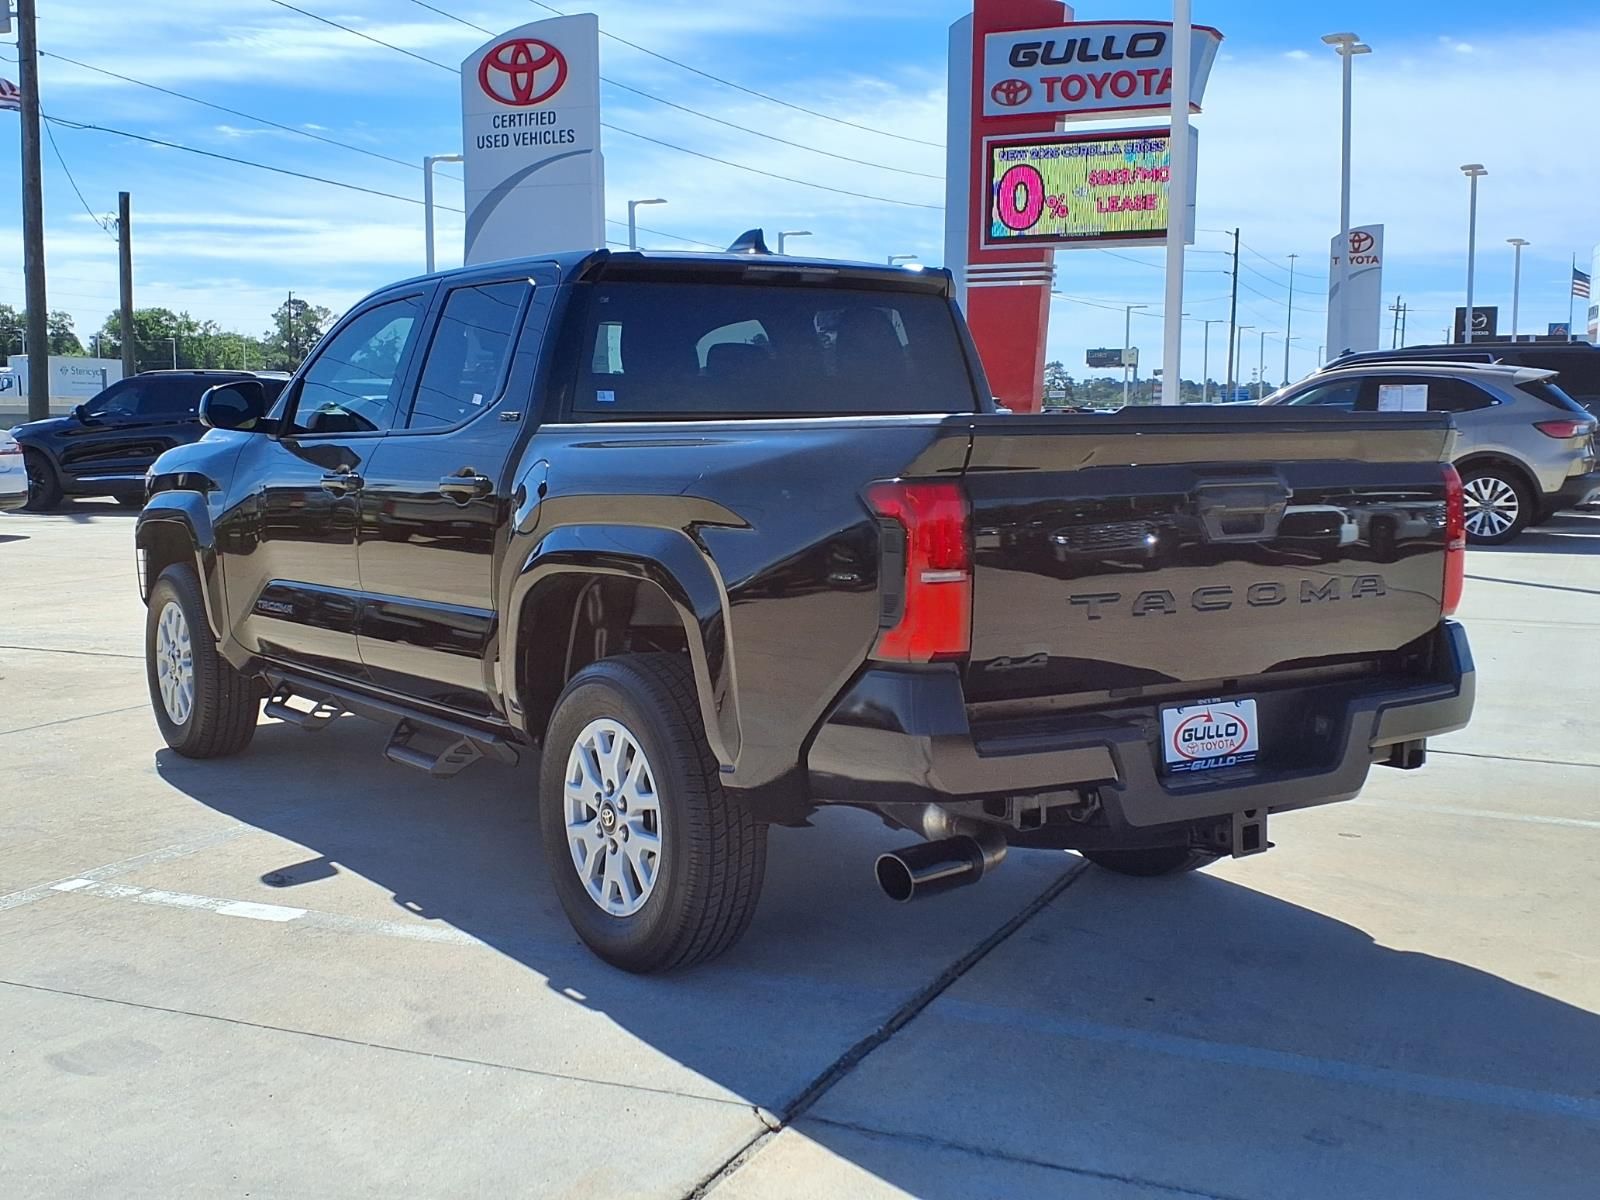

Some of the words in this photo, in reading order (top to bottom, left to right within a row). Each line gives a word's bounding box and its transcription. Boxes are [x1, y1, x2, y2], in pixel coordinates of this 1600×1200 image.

[1009, 31, 1166, 68] GULLO
[1040, 67, 1172, 103] TOYOTA
[492, 111, 557, 129] CERTIFIED
[477, 133, 509, 150] USED
[513, 129, 575, 147] VEHICLES
[999, 149, 1027, 161] NEW
[1061, 143, 1122, 158] COROLLA
[1123, 140, 1166, 154] CROSS
[1096, 194, 1157, 213] LEASE
[1332, 255, 1379, 265] TYOTA
[71, 366, 102, 378] Stericyc
[257, 600, 294, 614] TACOMA
[1070, 575, 1386, 620] TACOMA
[1182, 722, 1238, 743] GULLO
[1200, 739, 1236, 752] TOYOTA
[1190, 756, 1237, 771] GULLO
